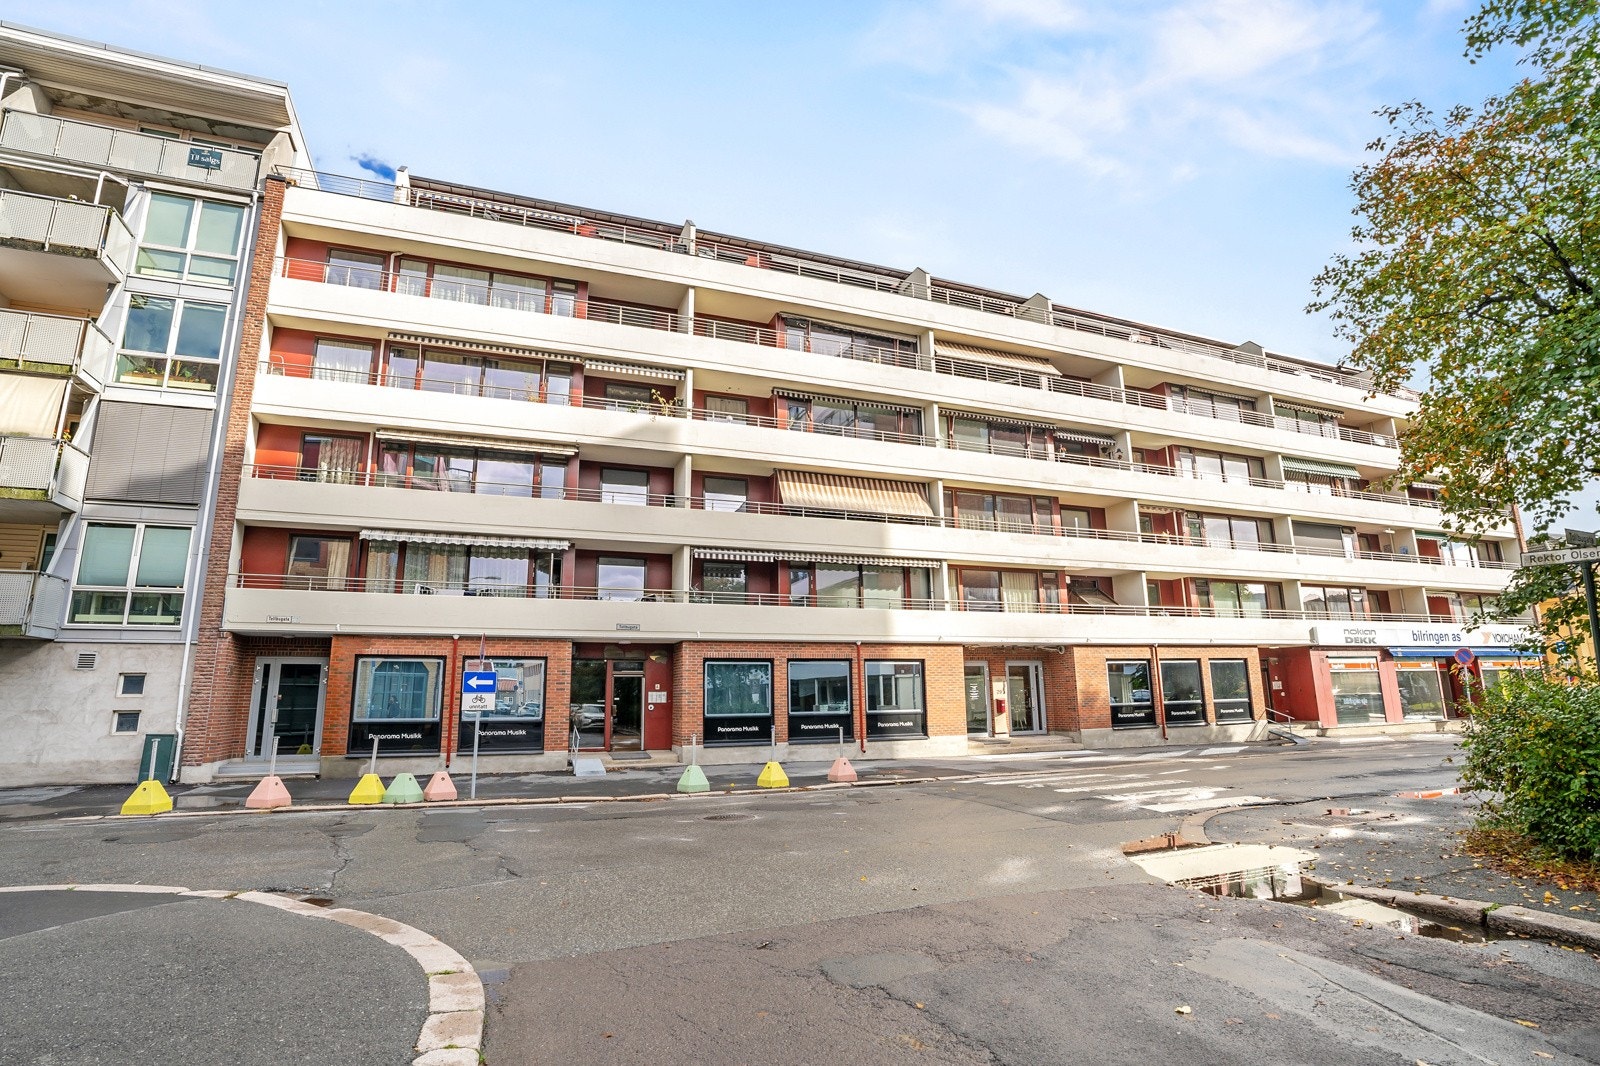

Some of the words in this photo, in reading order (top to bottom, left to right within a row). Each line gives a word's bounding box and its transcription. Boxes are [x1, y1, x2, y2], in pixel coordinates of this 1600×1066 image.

[190, 153, 200, 161] Til
[200, 156, 220, 165] salgs
[1529, 552, 1567, 563] Rektor
[1343, 628, 1377, 636] nokian
[1412, 630, 1450, 644] bilringen
[1452, 633, 1462, 642] as
[1345, 636, 1377, 644] DEKK
